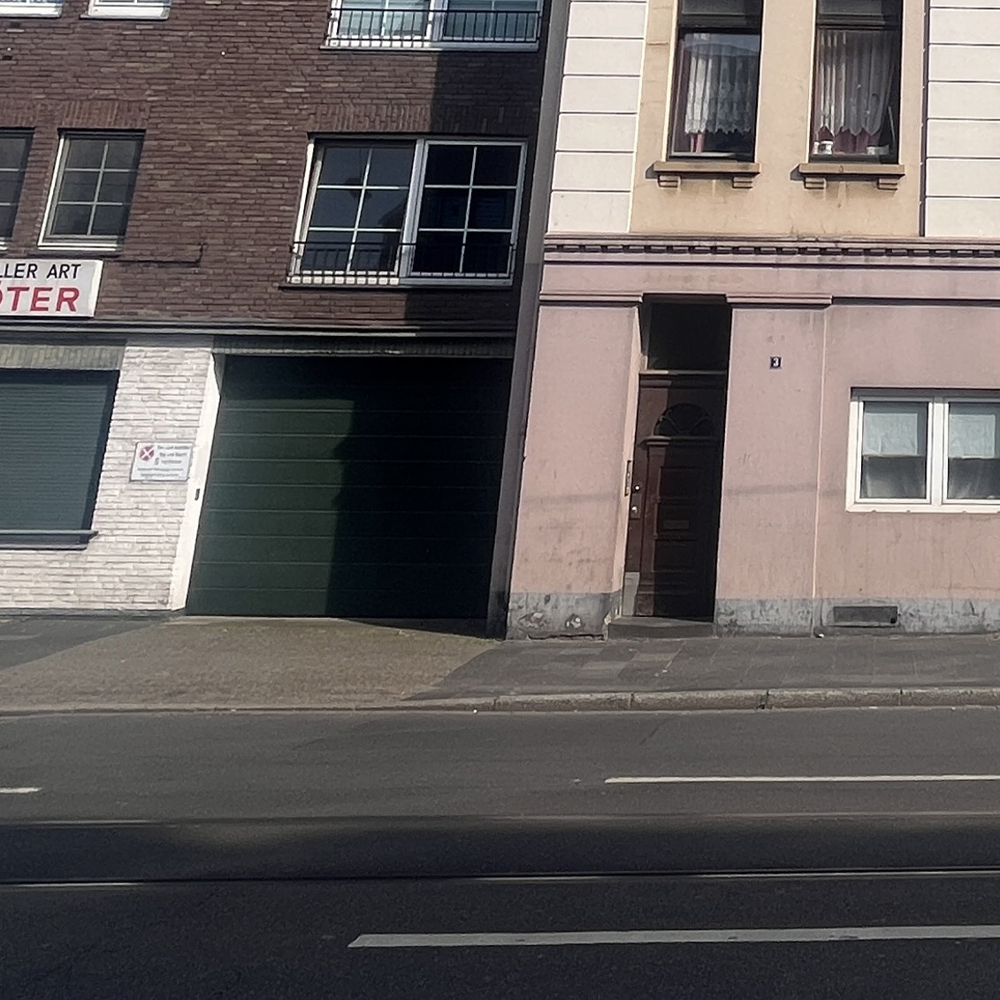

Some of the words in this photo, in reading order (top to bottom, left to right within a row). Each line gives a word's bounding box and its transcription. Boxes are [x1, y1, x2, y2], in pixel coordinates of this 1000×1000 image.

[0, 263, 37, 279] LER
[46, 263, 81, 279] ART
[0, 285, 80, 312] TER
